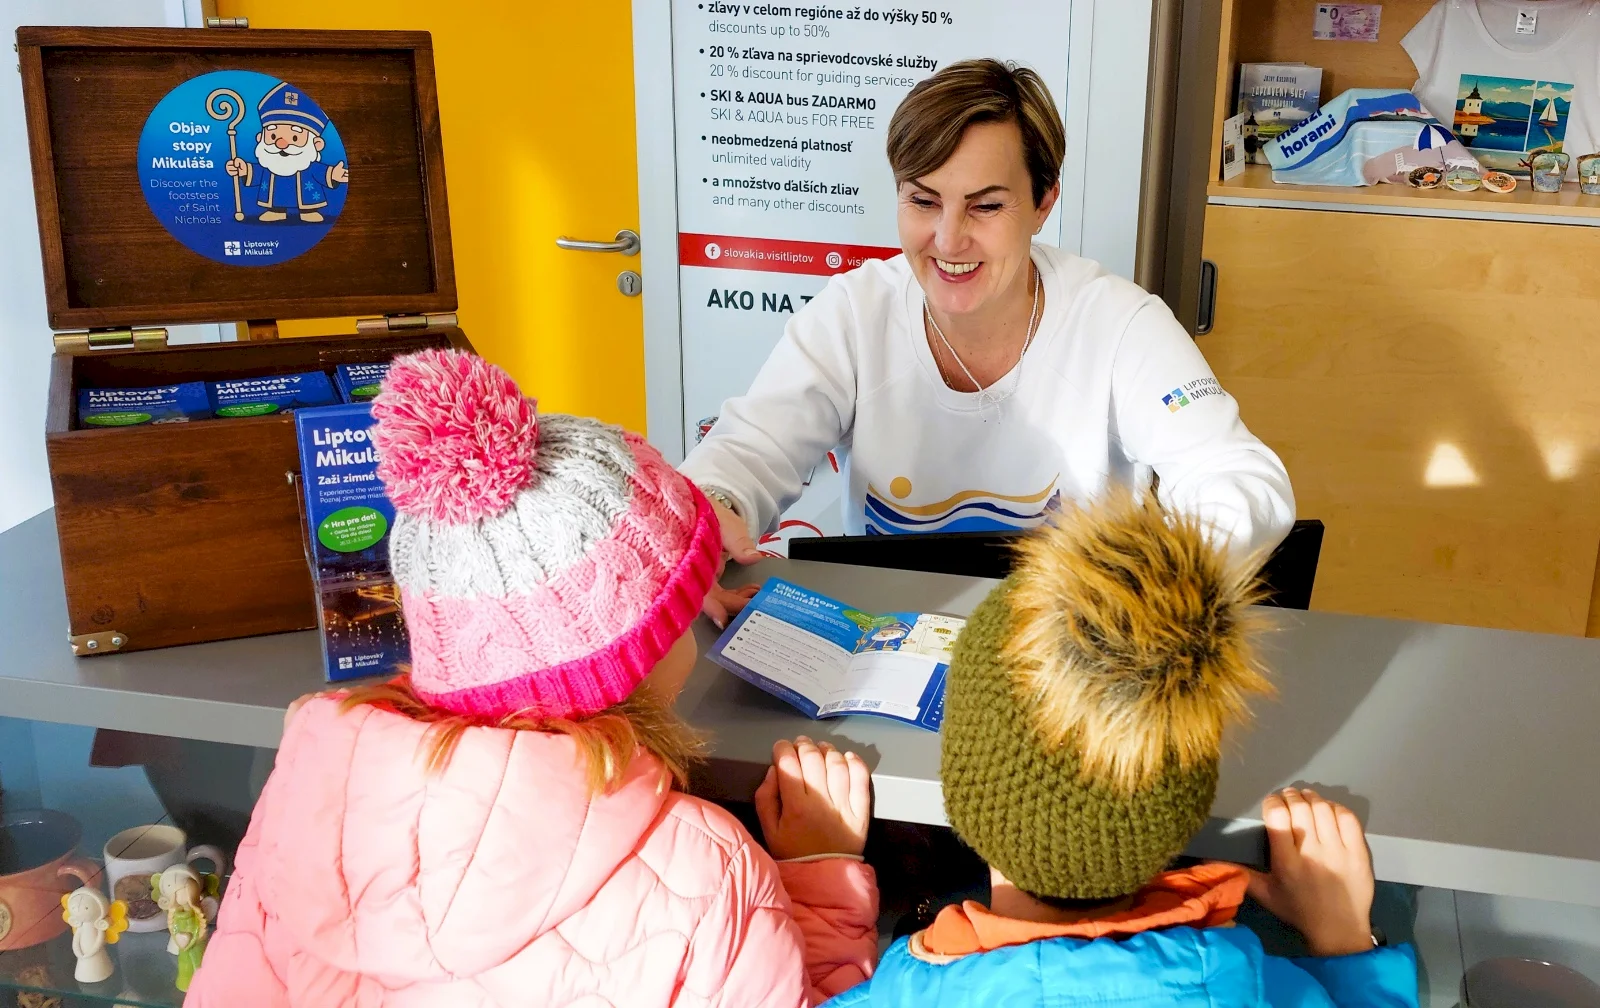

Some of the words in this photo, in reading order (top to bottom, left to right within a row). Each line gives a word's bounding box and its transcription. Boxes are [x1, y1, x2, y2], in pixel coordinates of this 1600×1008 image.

[708, 1, 740, 16] zľavy
[743, 5, 750, 14] v
[753, 4, 791, 16] celom
[795, 5, 843, 20] regióne
[846, 7, 861, 20] až
[864, 8, 879, 21] do
[883, 9, 918, 25] výšky
[921, 11, 937, 24] 50
[940, 11, 953, 25] %
[708, 20, 766, 35] discounts
[770, 25, 785, 38] up
[789, 24, 800, 37] to
[804, 24, 830, 38] 50%
[709, 46, 724, 58] 20
[727, 46, 739, 59] %
[742, 47, 774, 60] zľava
[778, 51, 792, 62] na
[796, 51, 892, 67] sprievodcovské
[896, 54, 937, 71] služby
[710, 64, 725, 77] 20
[727, 65, 739, 78] %
[742, 65, 793, 81] discount
[796, 67, 813, 82] for
[817, 69, 861, 87] guiding
[864, 73, 914, 88] services
[711, 90, 731, 102] SKI
[735, 91, 745, 103] &
[747, 91, 784, 106] AQUA
[786, 93, 809, 107] bus
[811, 95, 876, 110] ZADARMO
[711, 108, 731, 120] SKI
[734, 109, 744, 121] &
[747, 110, 784, 124] AQUA
[786, 112, 809, 126] bus
[812, 114, 838, 127] FOR
[841, 116, 875, 130] FREE
[169, 122, 210, 136] Objav
[1280, 113, 1336, 158] horami
[172, 141, 212, 153] stopy
[711, 134, 798, 150] neobmedzená
[801, 137, 853, 153] platnosť
[152, 156, 214, 169] Mikuláša
[712, 152, 767, 166] unlimited
[770, 155, 811, 171] validity
[150, 178, 196, 188] Discover
[199, 178, 218, 188] the
[712, 178, 720, 188] a
[722, 176, 781, 191] množstvo
[784, 179, 828, 194] ďalších
[830, 182, 859, 196] zliav
[168, 190, 220, 201] footsteps
[179, 202, 189, 212] of
[192, 203, 220, 212] Saint
[712, 194, 734, 206] and
[738, 197, 770, 212] many
[773, 197, 804, 211] other
[807, 199, 865, 215] discounts
[174, 215, 222, 224] Nicholas
[244, 240, 279, 250] Liptovský
[244, 248, 273, 256] Mikuláš
[724, 248, 814, 263] slovakia.visitliptov
[707, 288, 754, 311] AKO
[762, 292, 795, 314] NA
[215, 376, 301, 390] Liptovský
[217, 383, 286, 395] Mikuláš
[89, 386, 180, 397] Liptovský
[89, 394, 163, 402] Mikuláš
[313, 427, 376, 449] Liptov
[317, 474, 340, 485] Zaži
[342, 471, 375, 483] zimné
[319, 487, 354, 497] Experience
[342, 494, 366, 502] zimowe
[331, 520, 345, 528] Hra
[346, 517, 360, 526] pre
[361, 512, 376, 521] deti
[776, 583, 807, 598] Objav
[809, 596, 840, 610] stopy
